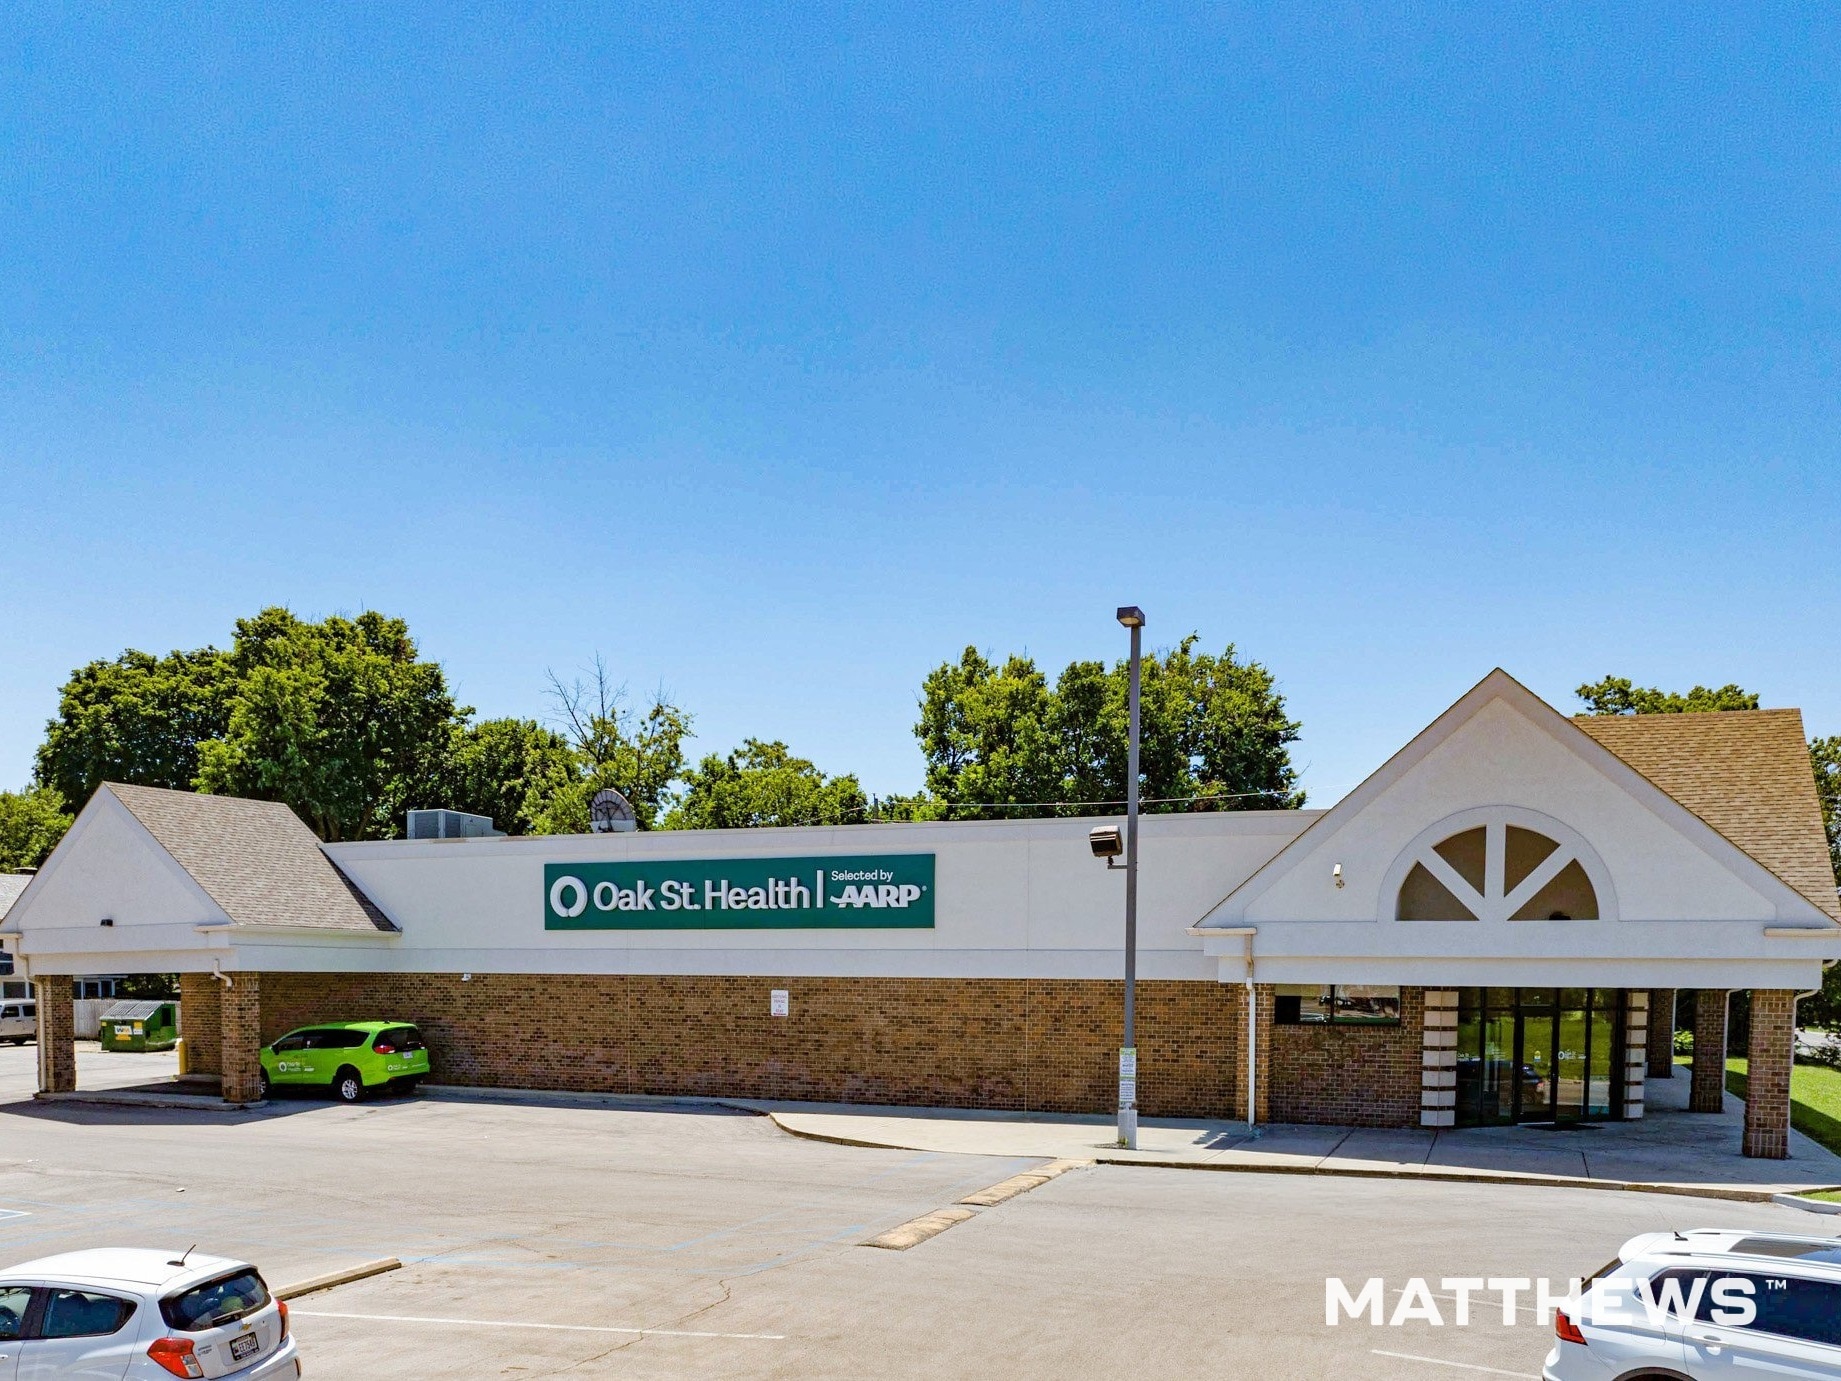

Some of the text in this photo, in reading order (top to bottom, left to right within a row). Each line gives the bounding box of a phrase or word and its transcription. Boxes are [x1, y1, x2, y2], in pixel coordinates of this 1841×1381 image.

[831, 869, 893, 882] Selected by
[593, 876, 811, 911] Oak St. Health
[830, 884, 921, 908] AARP
